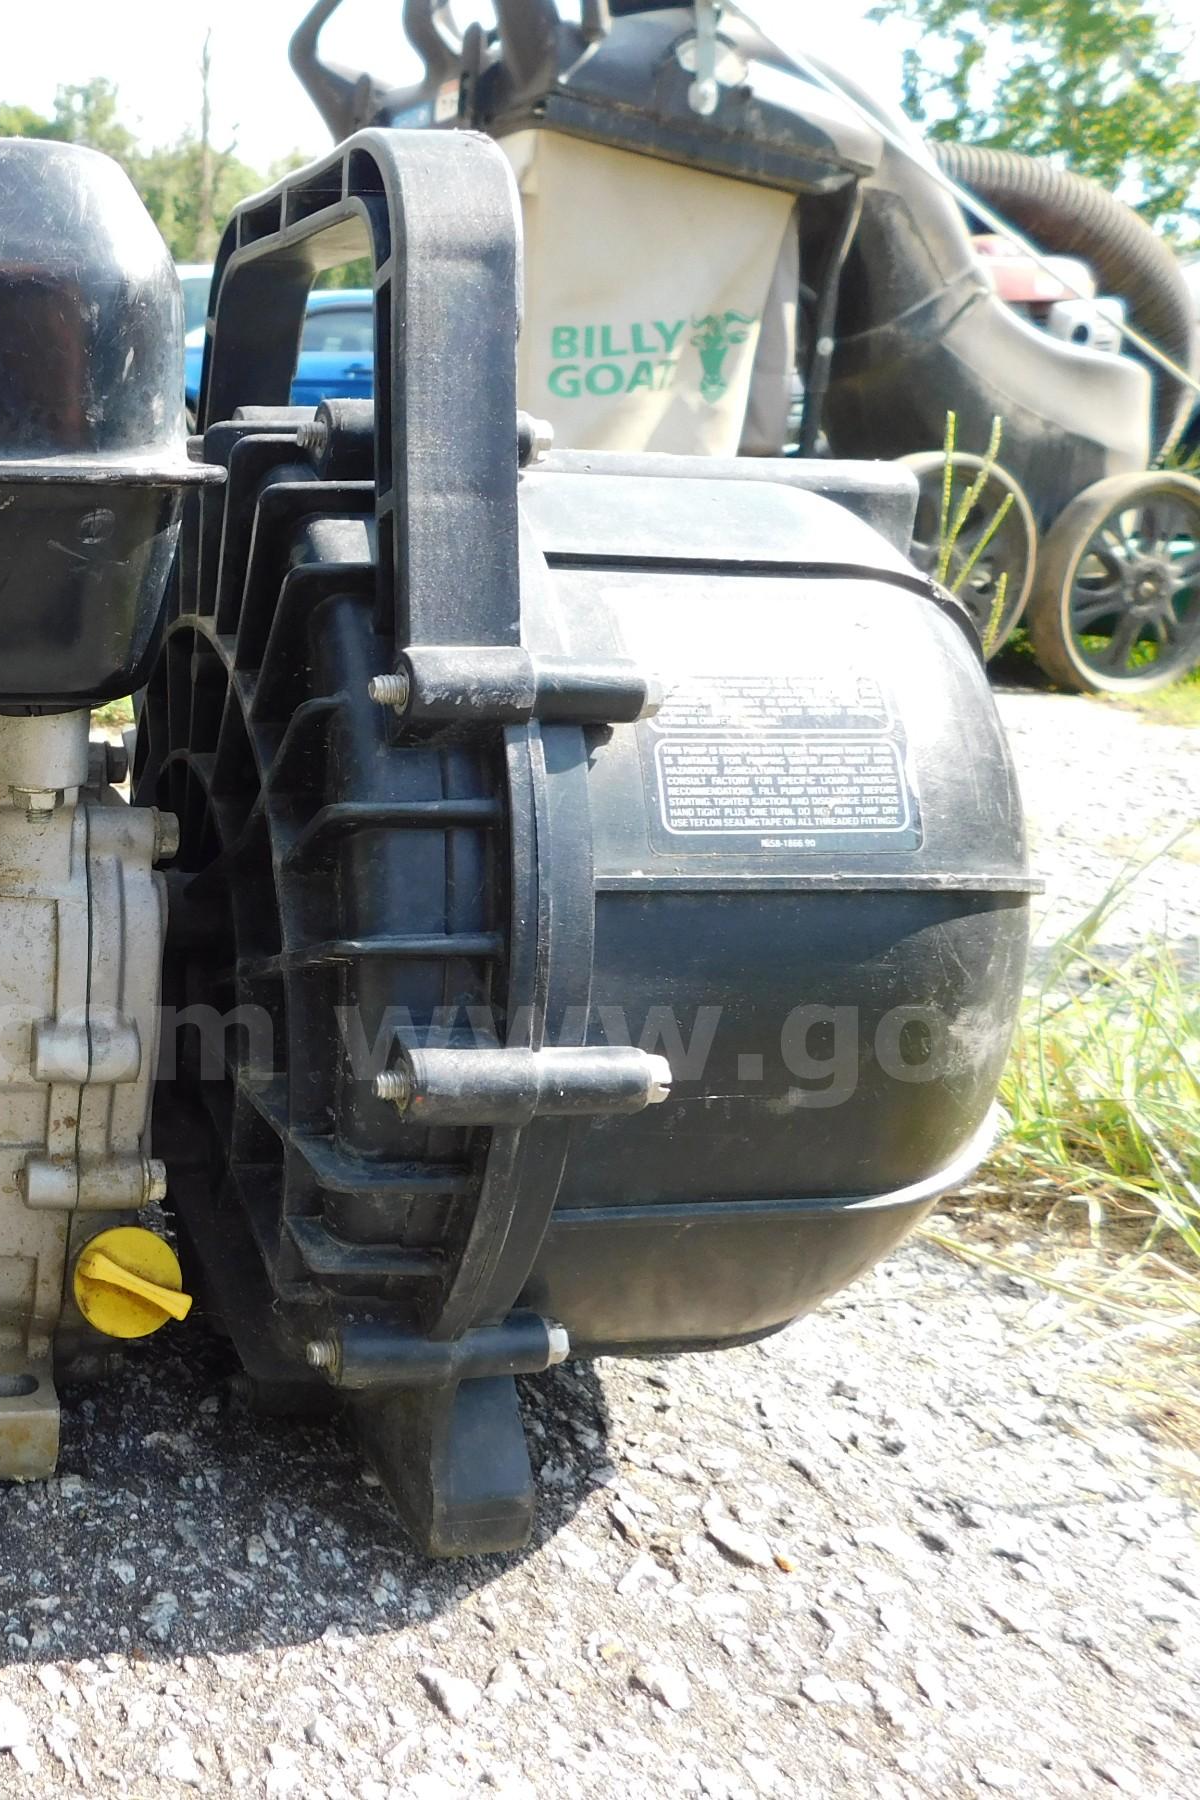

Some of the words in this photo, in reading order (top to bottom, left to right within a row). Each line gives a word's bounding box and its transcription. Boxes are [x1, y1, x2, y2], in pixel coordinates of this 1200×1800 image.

[552, 320, 687, 359] BILLY
[547, 360, 679, 399] GOAT
[666, 776, 706, 785] CONSULT
[712, 776, 750, 785] FACTORY
[754, 776, 772, 785] FOR
[778, 776, 816, 785] SPECIFIC
[820, 776, 848, 785] LIQUID
[758, 786, 778, 795] FILL
[780, 786, 804, 795] PUMP
[806, 786, 829, 795] WITH
[832, 786, 860, 795] LIQUID
[864, 786, 898, 795] BEFORE
[712, 797, 750, 806] TIGHTEN
[752, 797, 788, 806] SUCTION
[792, 797, 810, 805] AND
[862, 797, 899, 805] FITTINGS
[670, 807, 694, 816] HAND
[696, 807, 720, 816] TIGHT
[724, 807, 746, 816] PLUS
[750, 807, 768, 816] ONE
[834, 807, 852, 816] RUN
[856, 807, 880, 816] PUMP
[670, 818, 688, 827] USE
[690, 818, 722, 827] TEFLON
[724, 818, 760, 827] SEALING
[762, 817, 782, 826] TAPE
[798, 817, 814, 826] ALL
[814, 817, 860, 826] THREADED
